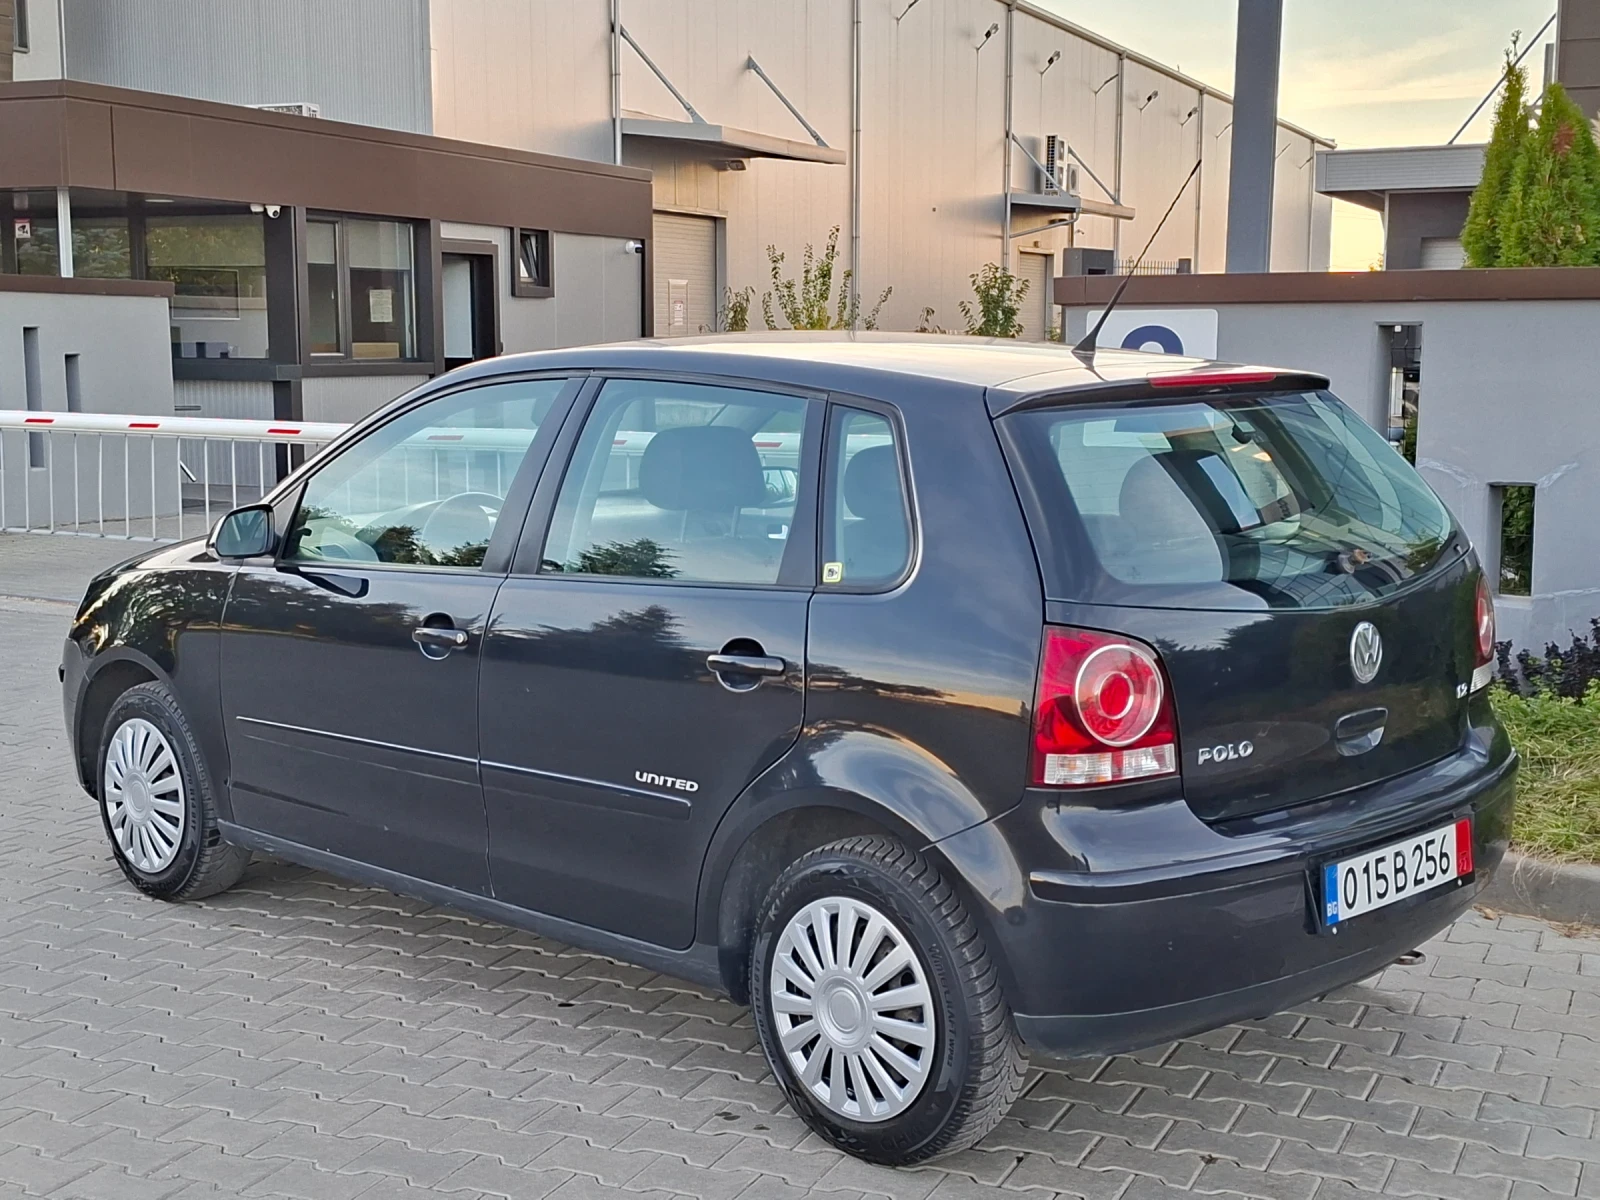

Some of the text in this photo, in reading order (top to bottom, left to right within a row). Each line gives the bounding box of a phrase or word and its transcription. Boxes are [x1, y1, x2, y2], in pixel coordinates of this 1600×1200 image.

[1197, 740, 1254, 766] POLO
[635, 770, 699, 792] UNITED
[1343, 834, 1451, 911] 015B256
[1326, 901, 1338, 917] BG
